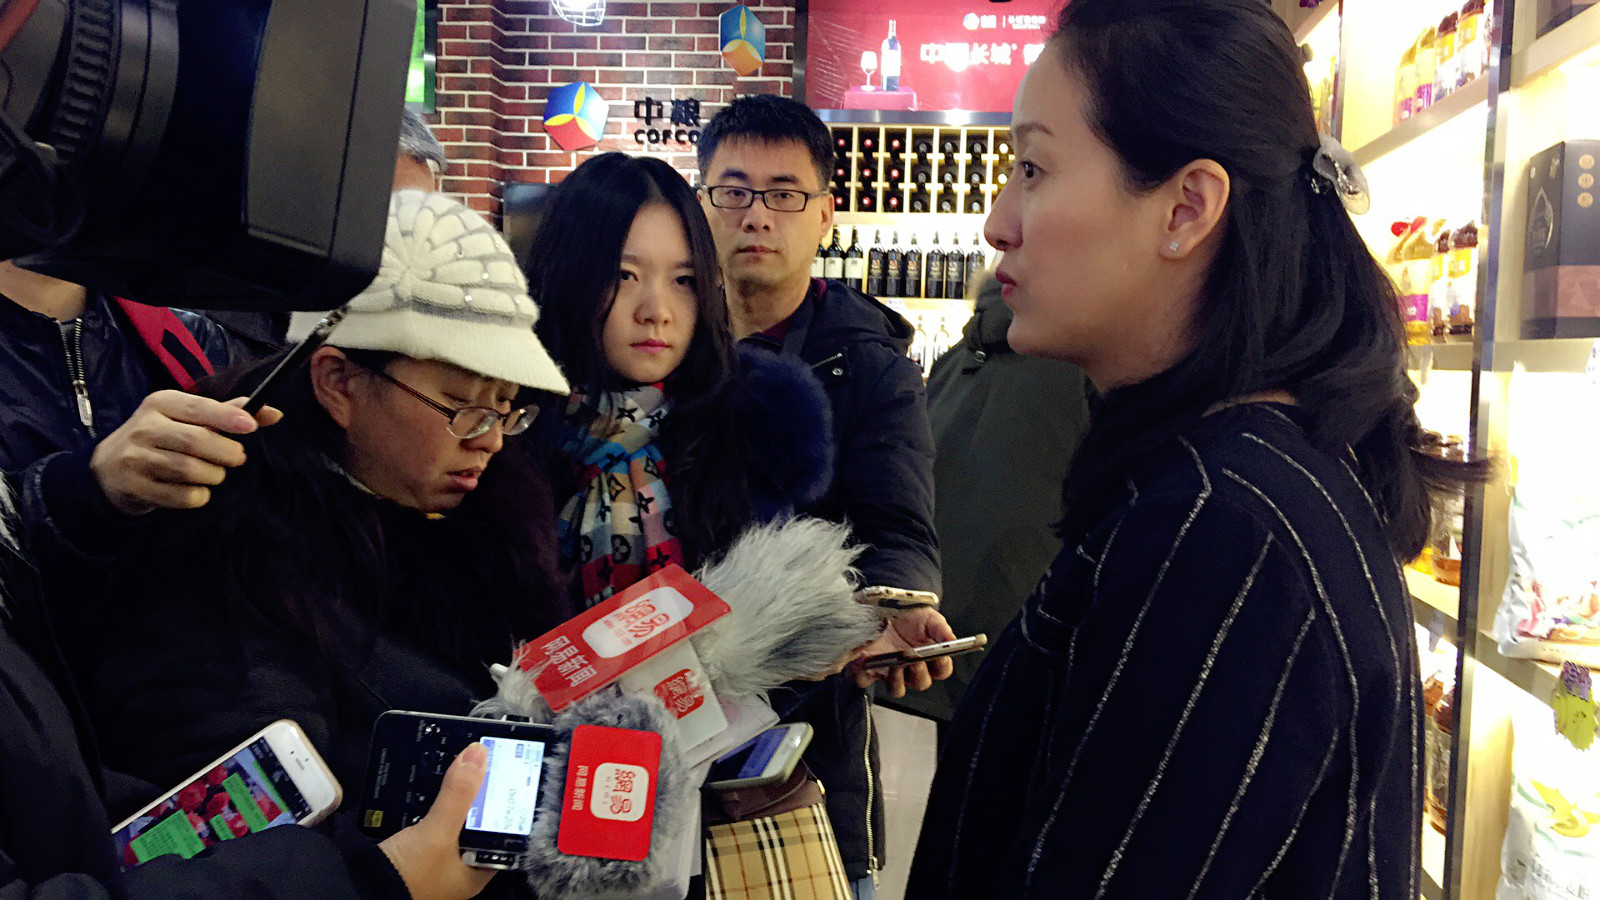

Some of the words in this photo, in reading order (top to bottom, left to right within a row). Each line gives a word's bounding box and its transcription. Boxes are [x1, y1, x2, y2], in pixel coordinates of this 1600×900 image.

[634, 96, 701, 128] 中粮
[543, 635, 598, 688] 网易新闻
